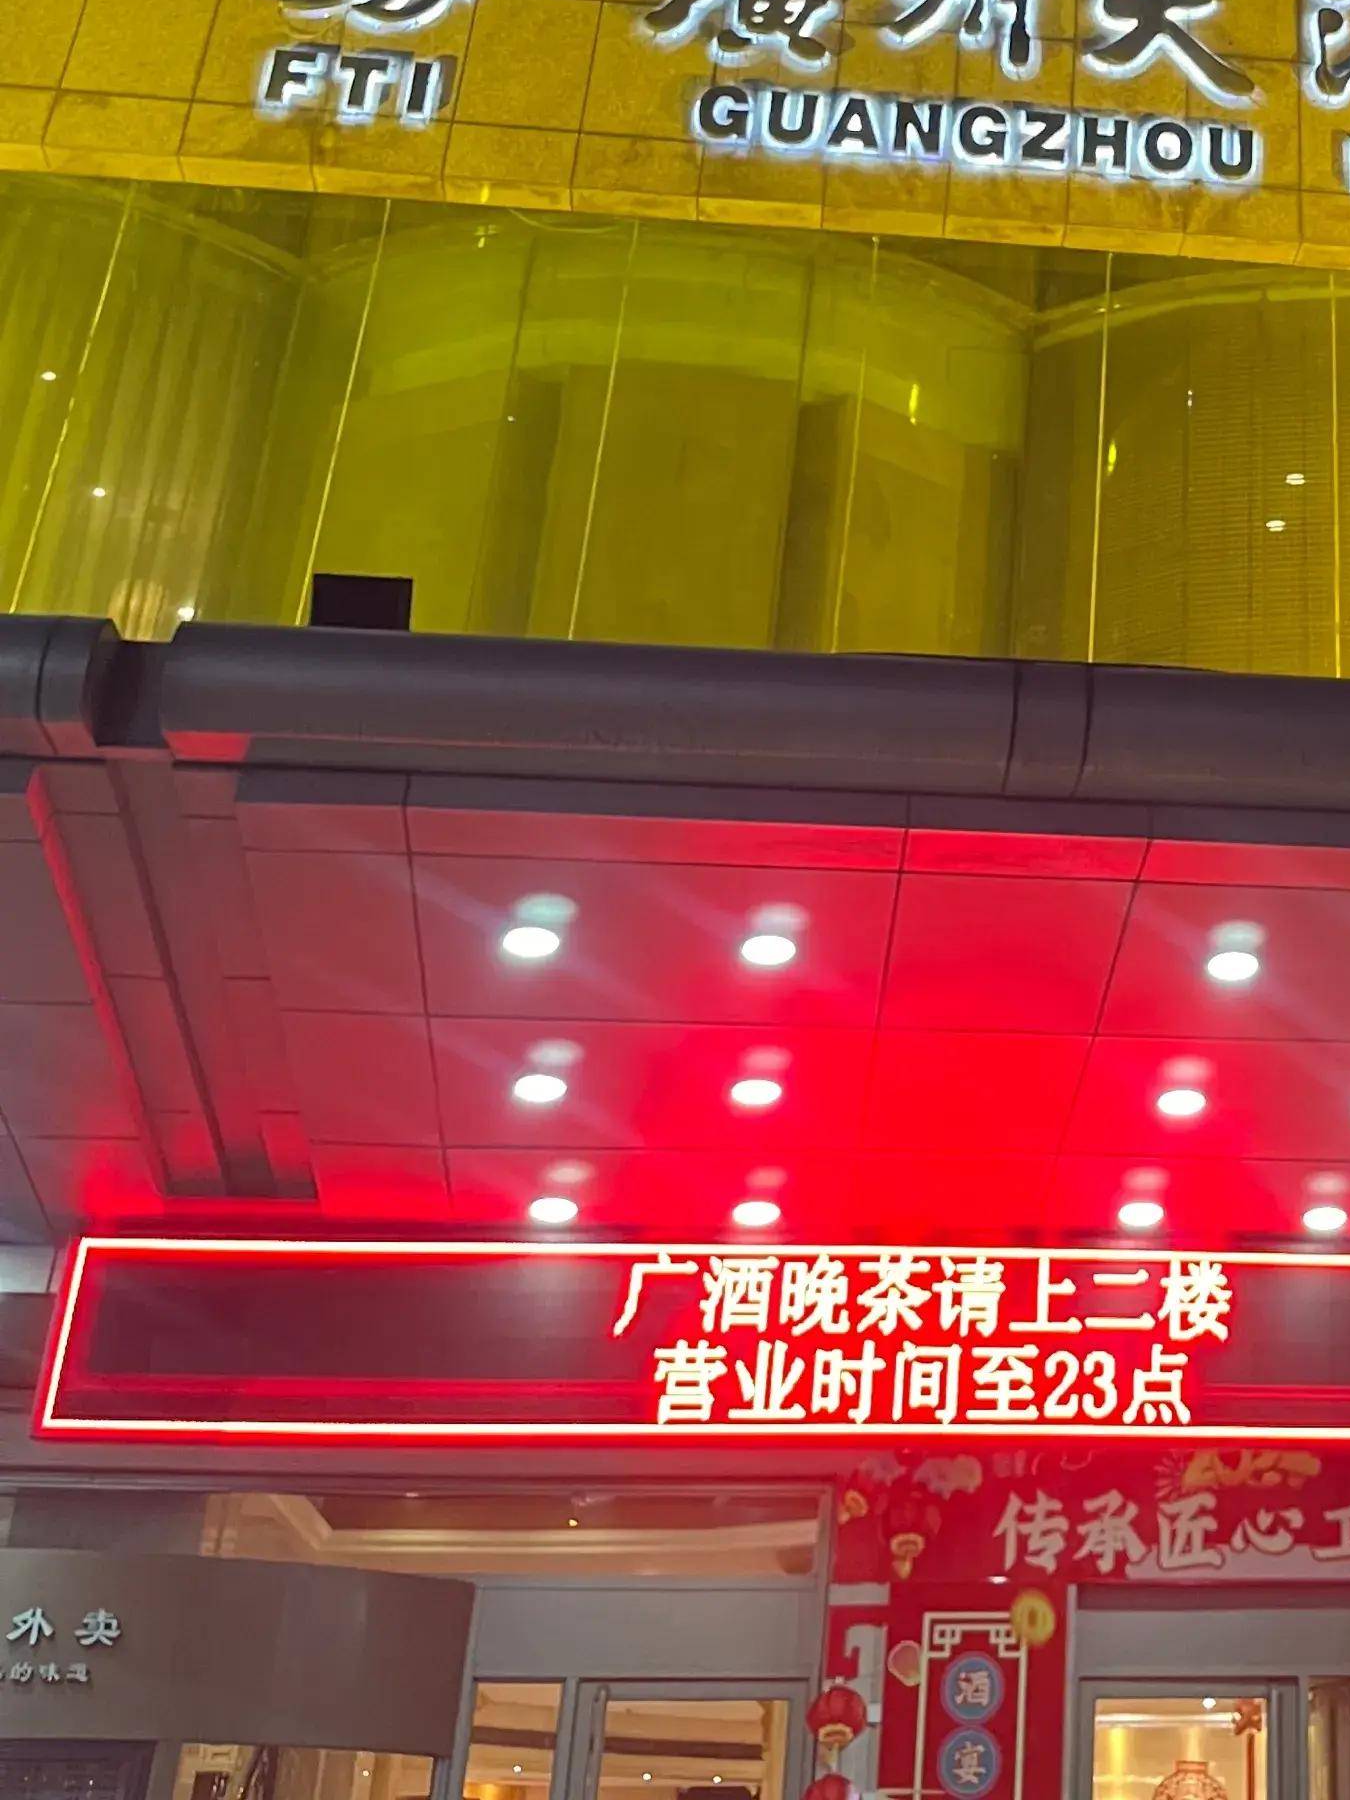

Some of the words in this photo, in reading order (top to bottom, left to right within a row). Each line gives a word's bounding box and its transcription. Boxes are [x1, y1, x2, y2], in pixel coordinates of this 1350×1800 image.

[262, 49, 434, 122] FTI
[694, 80, 1262, 188] GUANGZHOU
[610, 1252, 1236, 1340] 广酒晚茶请上二楼
[652, 1338, 1194, 1426] 营业时间至23点
[0, 1661, 88, 1683] 的味道
